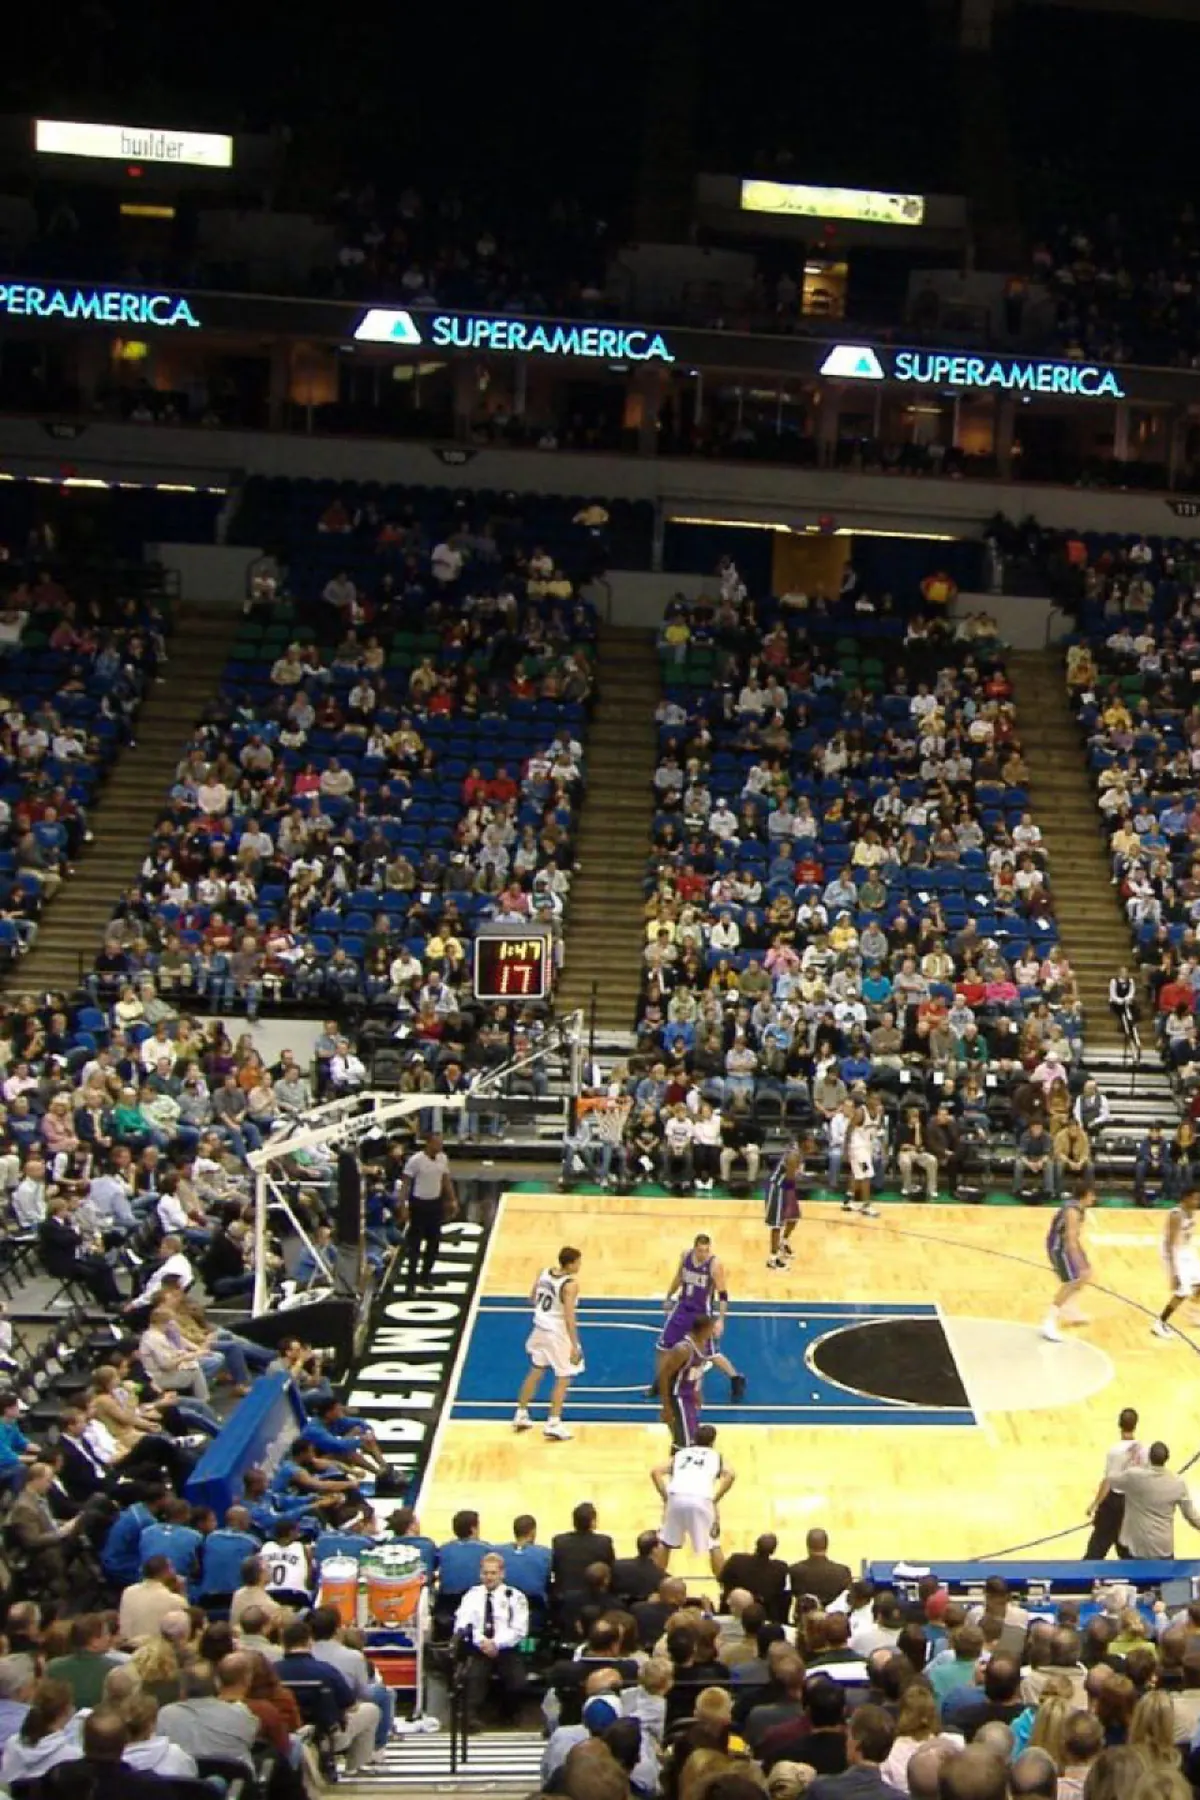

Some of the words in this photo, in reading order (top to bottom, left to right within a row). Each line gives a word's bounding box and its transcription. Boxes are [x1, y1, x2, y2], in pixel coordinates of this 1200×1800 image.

[120, 129, 184, 159] builder
[432, 316, 674, 362] SUPERAMERICA
[894, 352, 1125, 399] SUPERAMERICA
[500, 941, 541, 960] 1:47
[500, 965, 533, 993] 17
